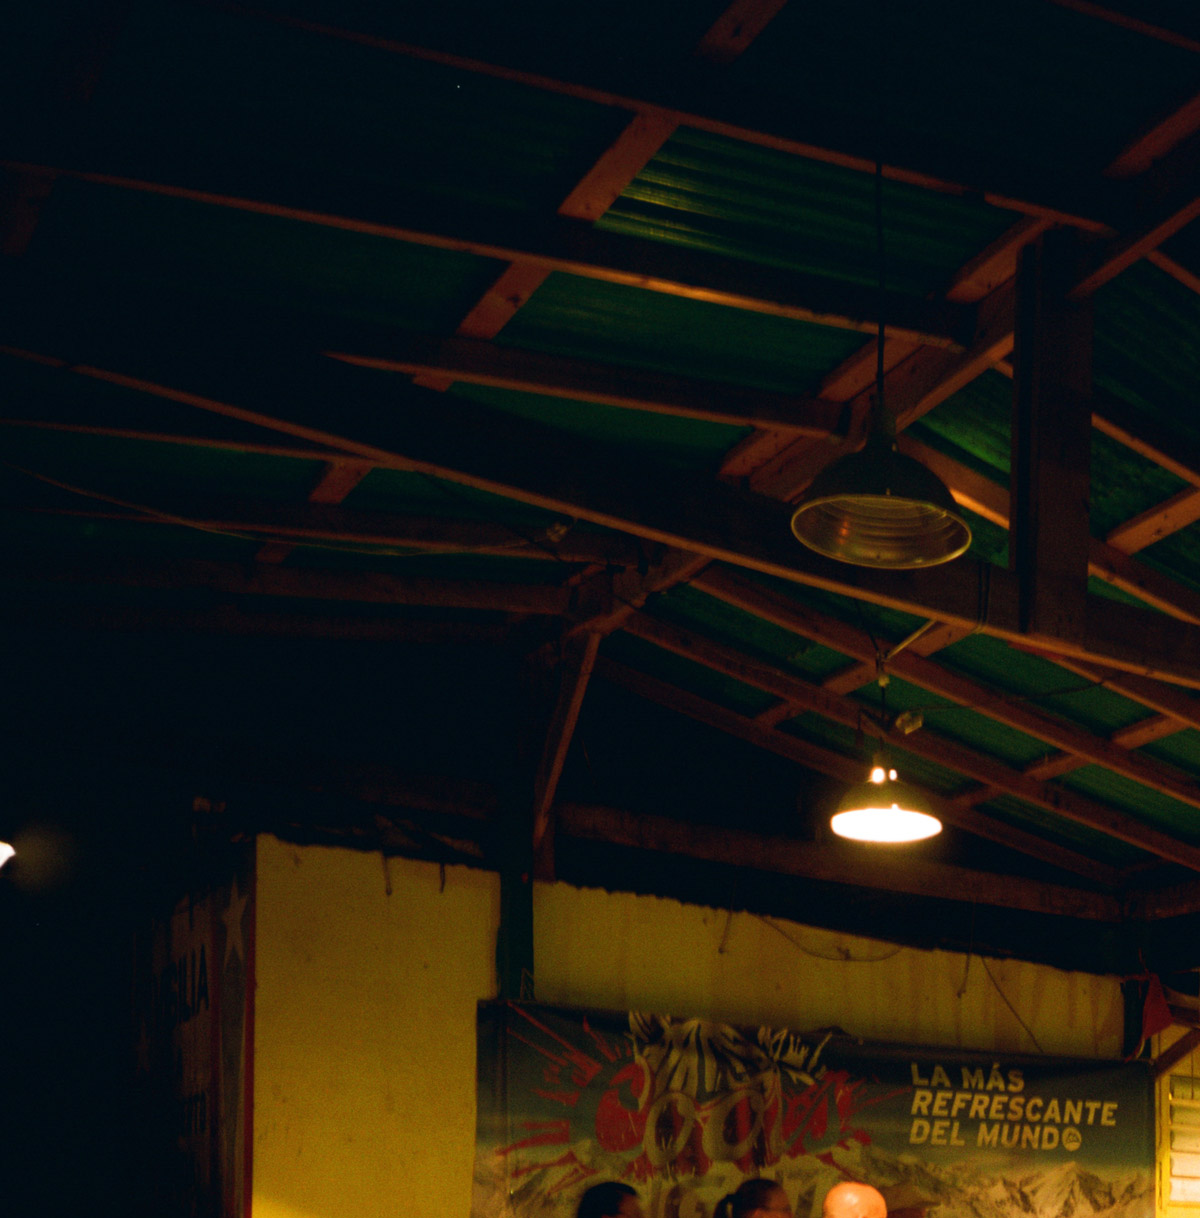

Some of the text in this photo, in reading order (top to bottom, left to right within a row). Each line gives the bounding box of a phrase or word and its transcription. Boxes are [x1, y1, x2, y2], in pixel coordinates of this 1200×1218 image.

[911, 1062, 1025, 1092] LA MÁS
[911, 1090, 1119, 1127] REFRESCANTE
[909, 1118, 966, 1147] DEL
